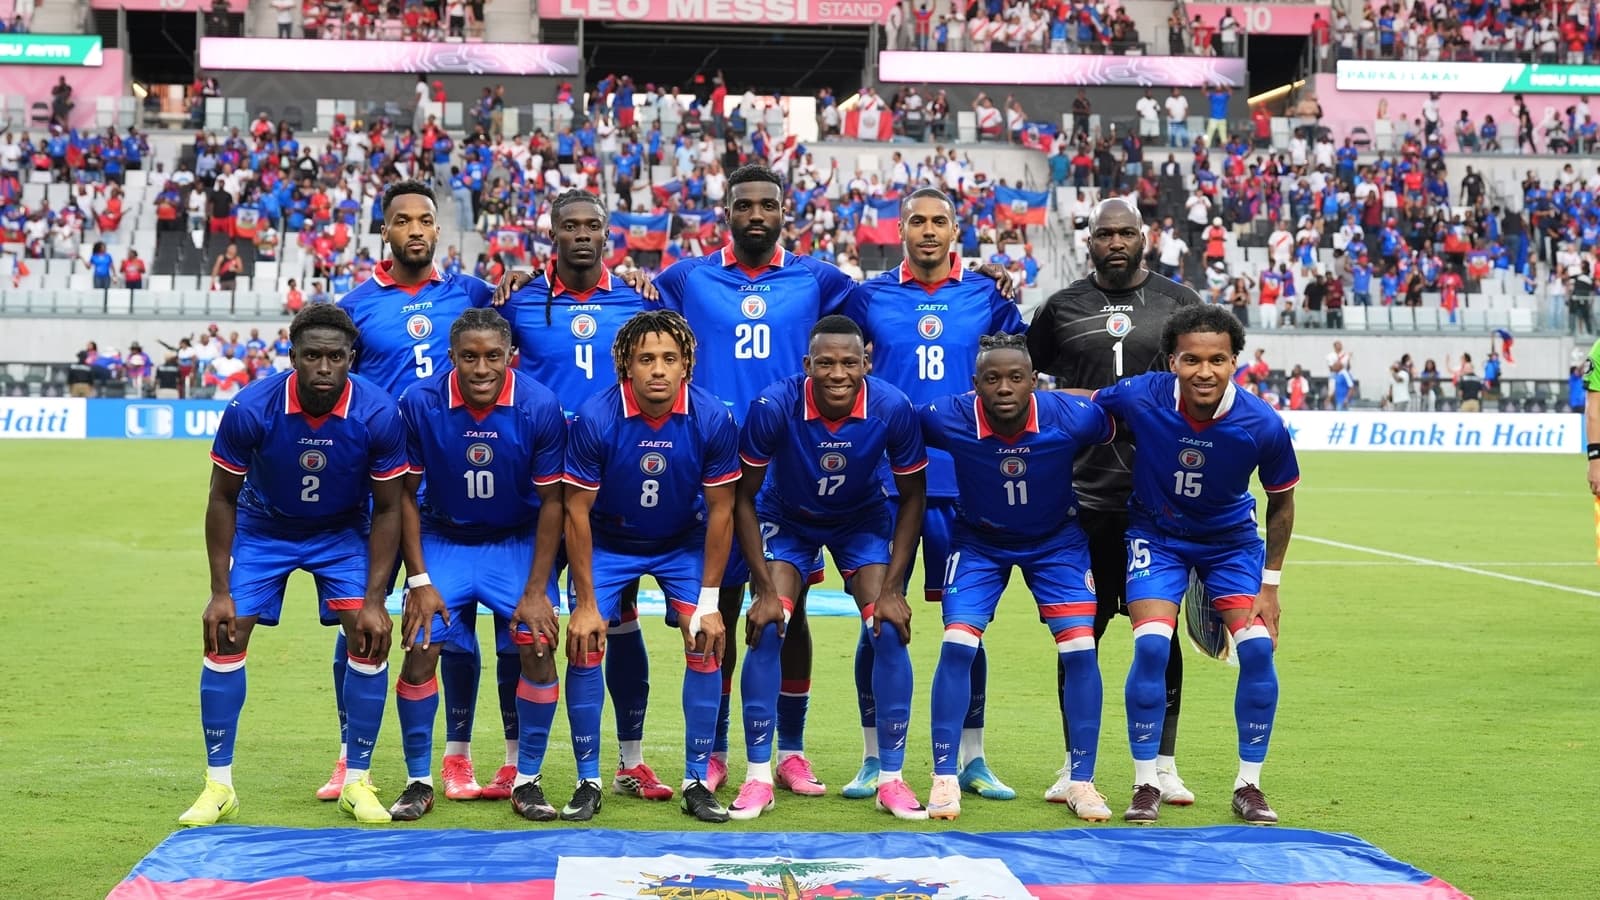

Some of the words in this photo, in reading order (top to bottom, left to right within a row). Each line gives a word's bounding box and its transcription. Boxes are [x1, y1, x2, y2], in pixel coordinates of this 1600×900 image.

[561, 0, 650, 20] LEO
[667, 0, 809, 22] MESSI
[818, 2, 883, 17] STAND
[1243, 7, 1272, 32] 10
[737, 284, 771, 292] SAETA
[400, 301, 433, 313] SAETA
[567, 304, 602, 312] SAETA
[1100, 304, 1134, 312] SAETA
[735, 323, 771, 359] 20
[413, 343, 433, 378] 5
[575, 344, 593, 379] 4
[915, 344, 945, 380] 18
[1112, 341, 1123, 377] 1
[463, 430, 498, 438] SAETA
[1328, 422, 1359, 444] #1
[1369, 423, 1445, 446] Bank
[1455, 423, 1480, 446] in
[1492, 424, 1565, 447] Haiti
[297, 437, 334, 446] SAETA
[637, 440, 673, 448] SAETA
[817, 441, 852, 449] SAETA
[1178, 437, 1213, 448] SAETA
[995, 446, 1031, 454] SAETA
[301, 475, 320, 502] 2
[463, 470, 495, 499] 10
[817, 474, 846, 496] 17
[1173, 470, 1203, 498] 15
[640, 479, 659, 508] 8
[1003, 480, 1028, 506] 11
[943, 551, 960, 586] 11
[753, 719, 772, 728] FHF
[206, 729, 226, 737] FHF
[575, 735, 593, 743] FHF
[358, 737, 373, 746] FHF
[935, 742, 950, 750] FHF
[1072, 748, 1087, 756] FHF
